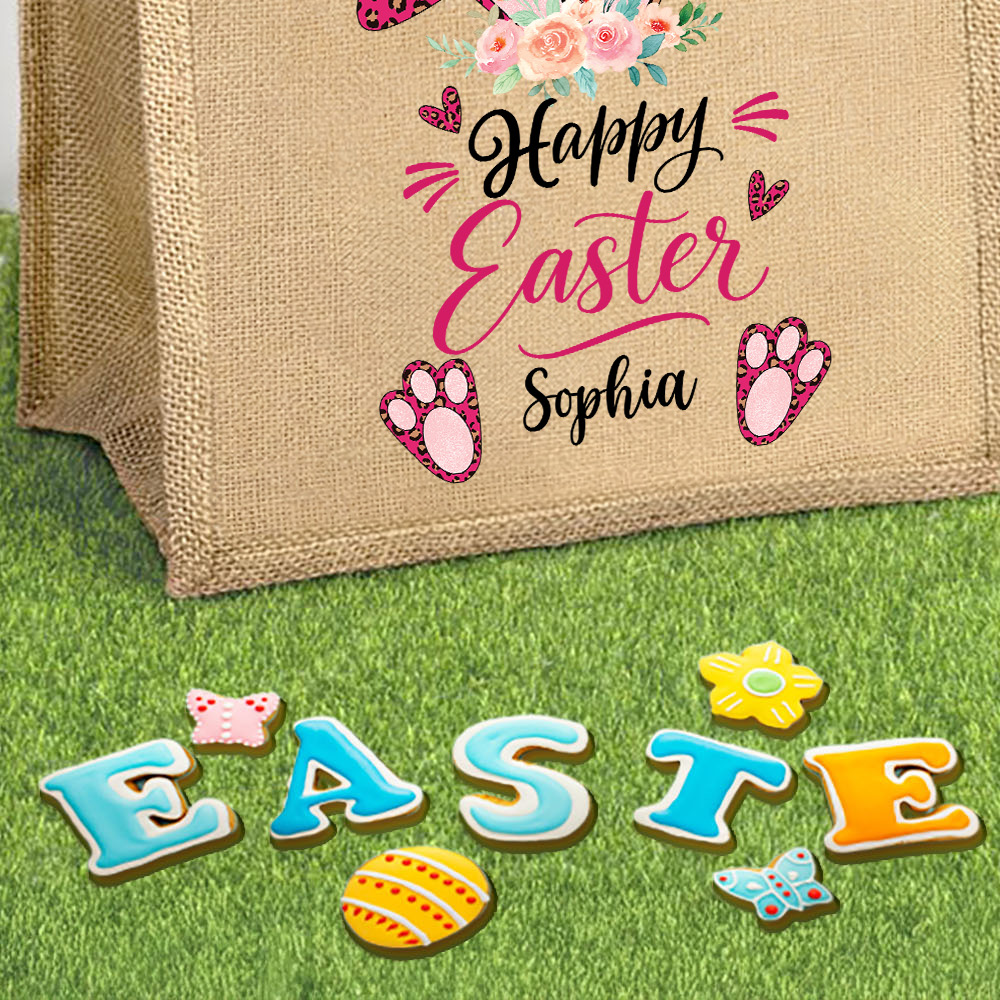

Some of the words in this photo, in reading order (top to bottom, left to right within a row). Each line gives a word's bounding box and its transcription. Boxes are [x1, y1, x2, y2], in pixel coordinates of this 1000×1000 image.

[468, 97, 723, 199] Happy
[432, 190, 769, 355] Easter
[522, 354, 698, 445] Sophia
